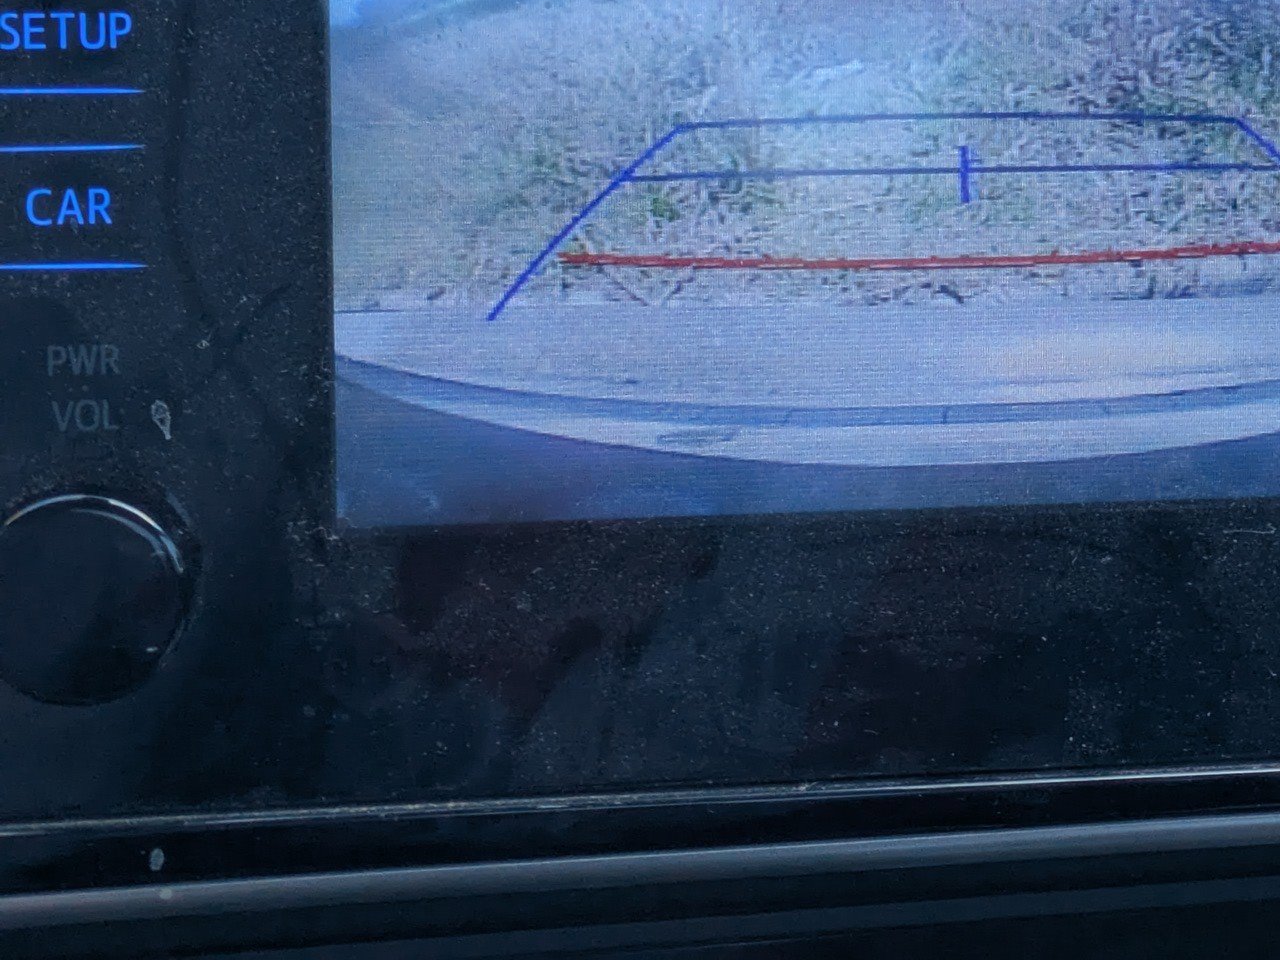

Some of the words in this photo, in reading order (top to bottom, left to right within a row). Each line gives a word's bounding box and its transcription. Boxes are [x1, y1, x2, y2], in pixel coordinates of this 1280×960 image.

[0, 11, 132, 51] SETUP
[26, 187, 112, 226] CAR
[46, 345, 121, 378] PWR
[51, 398, 119, 432] VOL
